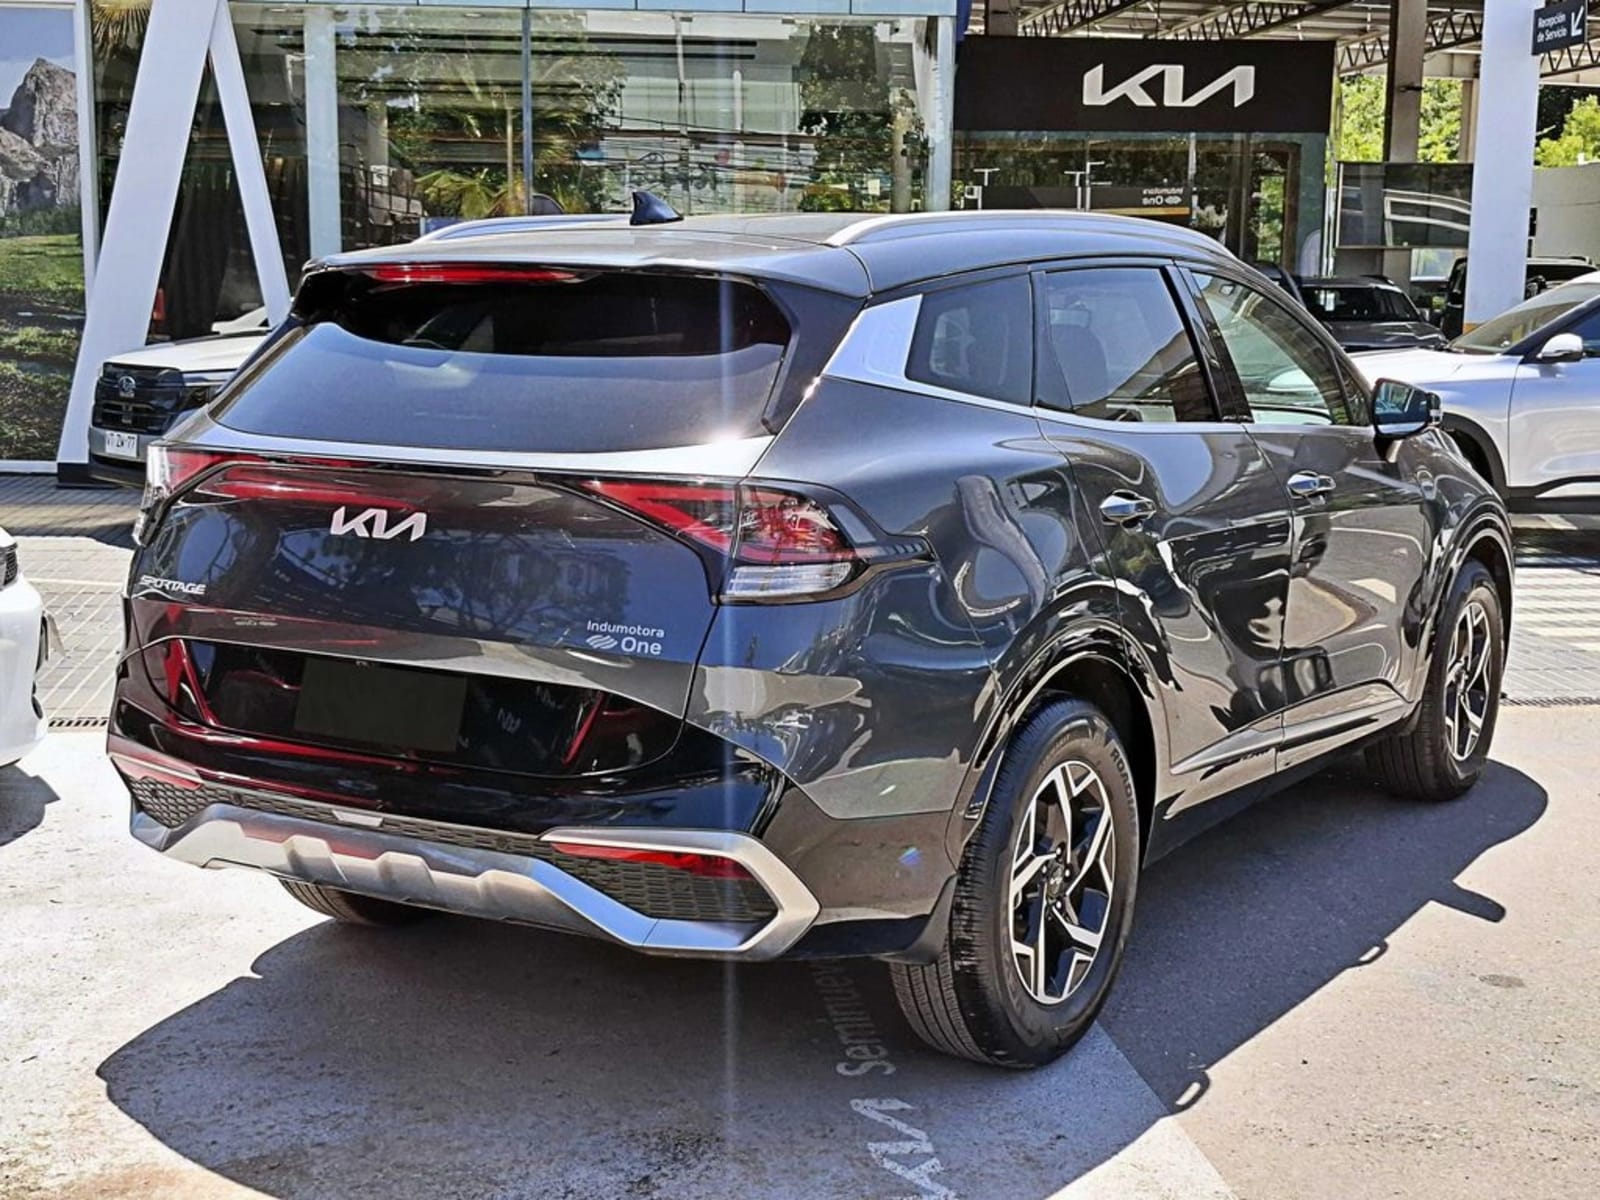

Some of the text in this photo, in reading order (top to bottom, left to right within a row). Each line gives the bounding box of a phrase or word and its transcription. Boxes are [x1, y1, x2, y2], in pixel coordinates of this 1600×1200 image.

[1082, 63, 1255, 108] KIA
[330, 505, 428, 542] KIA
[140, 575, 206, 595] SPORTAGE
[586, 620, 665, 638] Indumotora
[621, 636, 663, 655] One
[809, 958, 897, 1076] Seminuev
